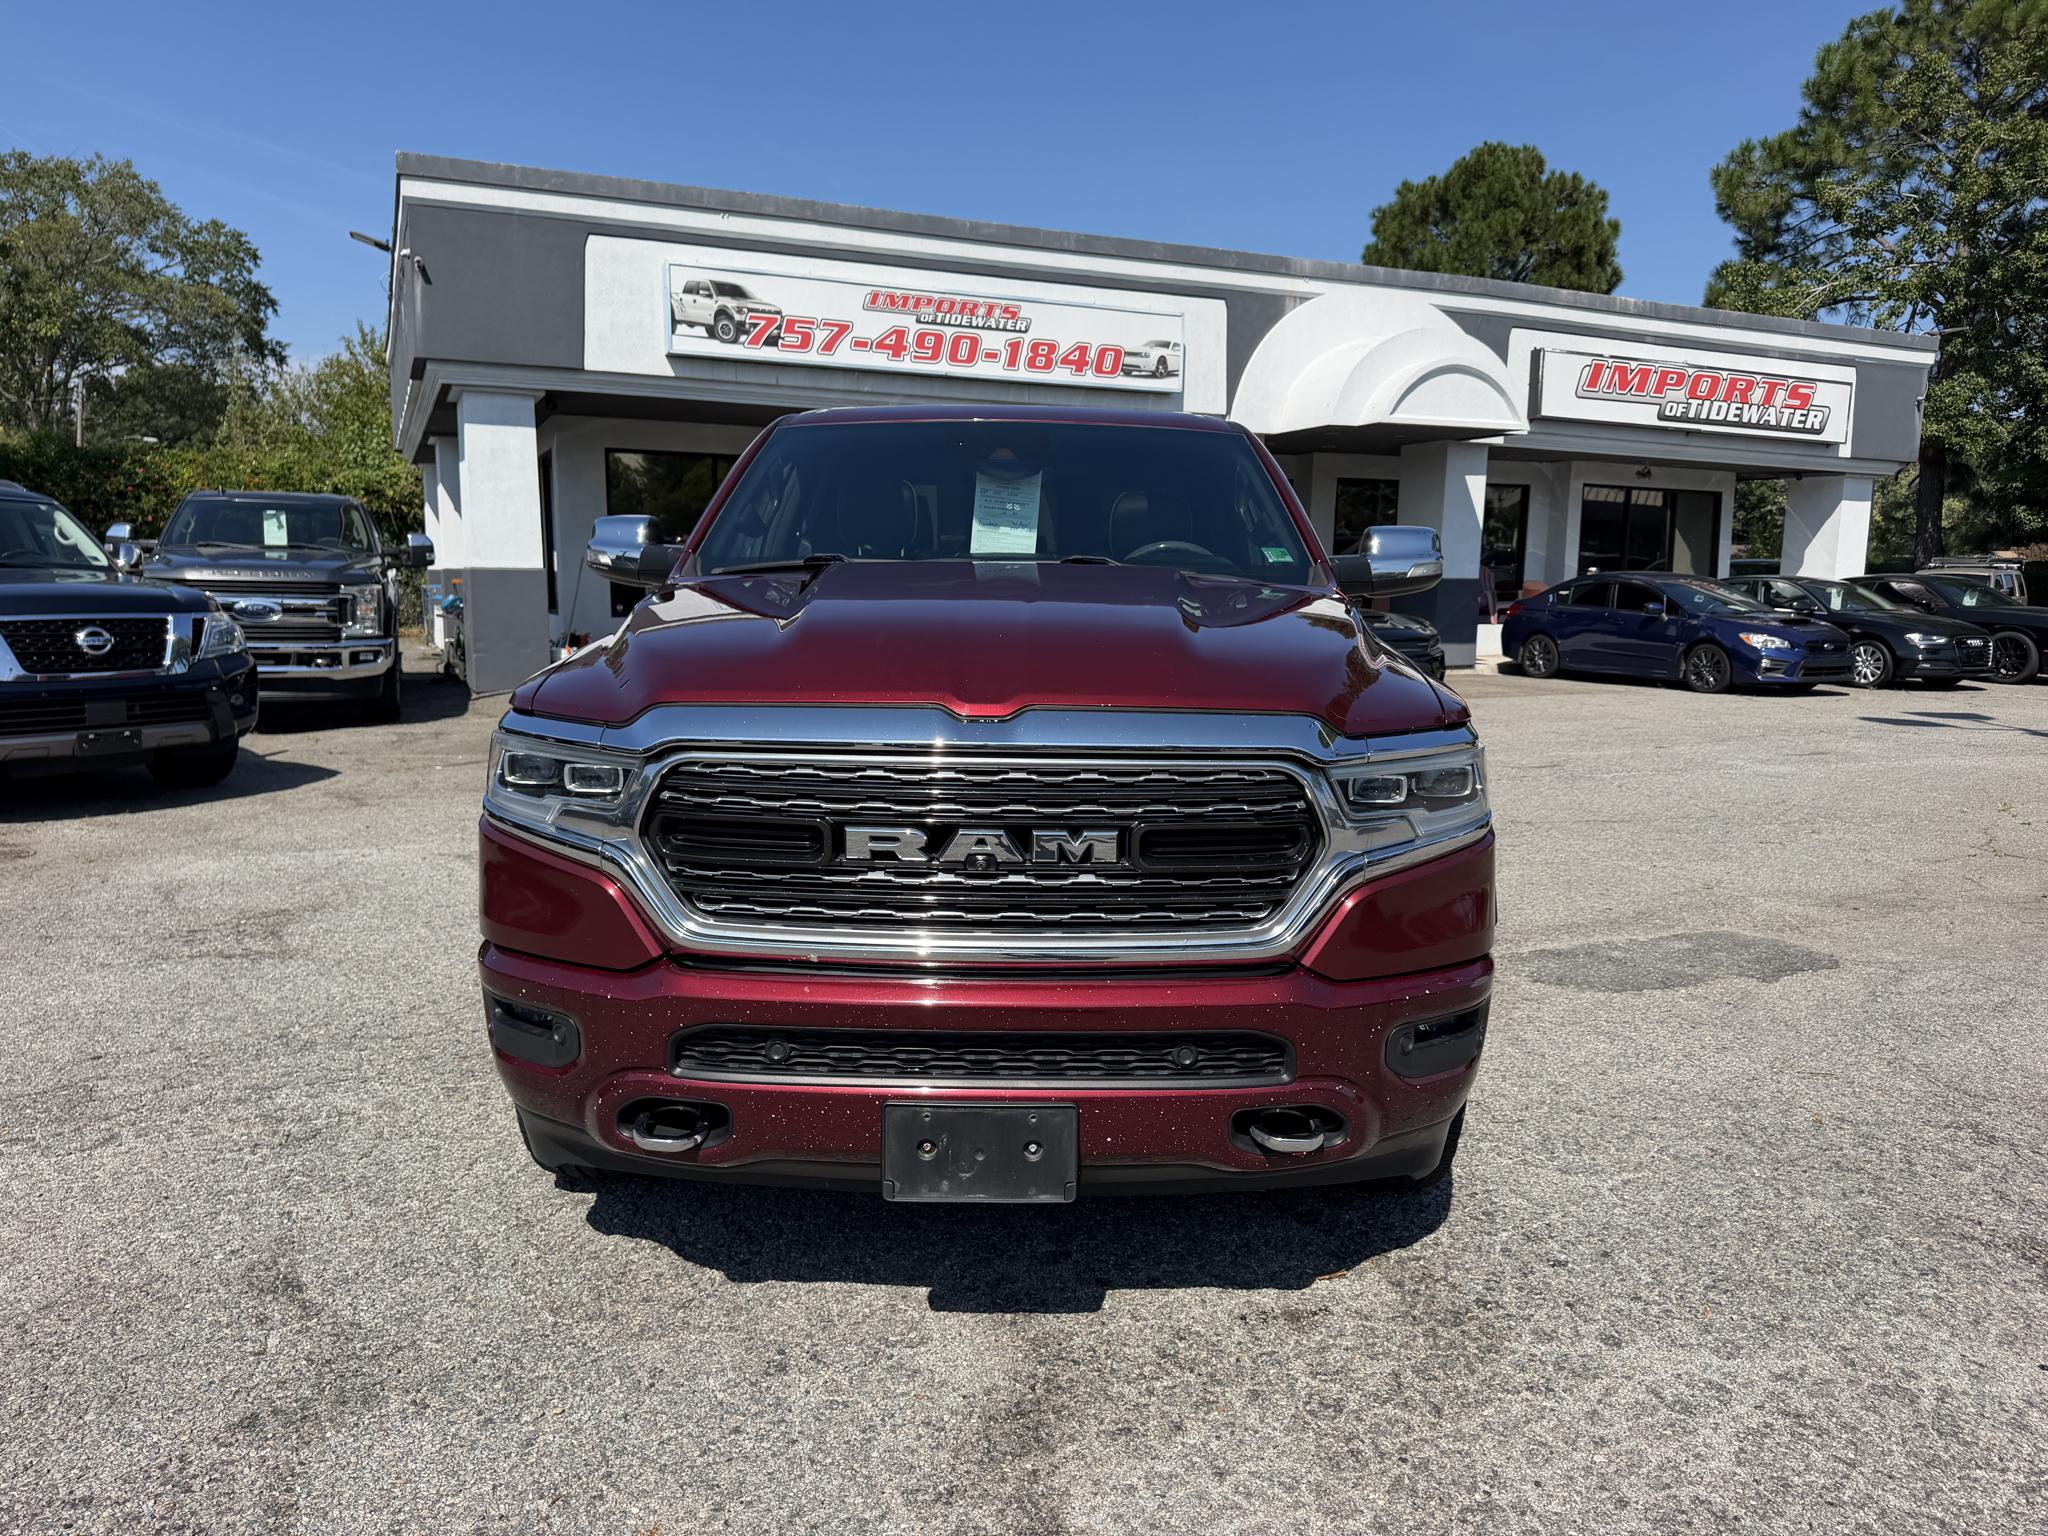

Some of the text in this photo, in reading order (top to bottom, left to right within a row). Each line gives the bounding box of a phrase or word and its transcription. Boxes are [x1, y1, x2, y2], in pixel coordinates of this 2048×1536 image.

[867, 290, 1021, 321] IMPORTS
[933, 313, 1030, 331] TIDEWATER
[744, 313, 1126, 378] 757-490-1840
[1583, 359, 1817, 410] IMPORTS
[1664, 399, 1824, 430] OF TIDEWATER
[844, 826, 1120, 864] RAM
